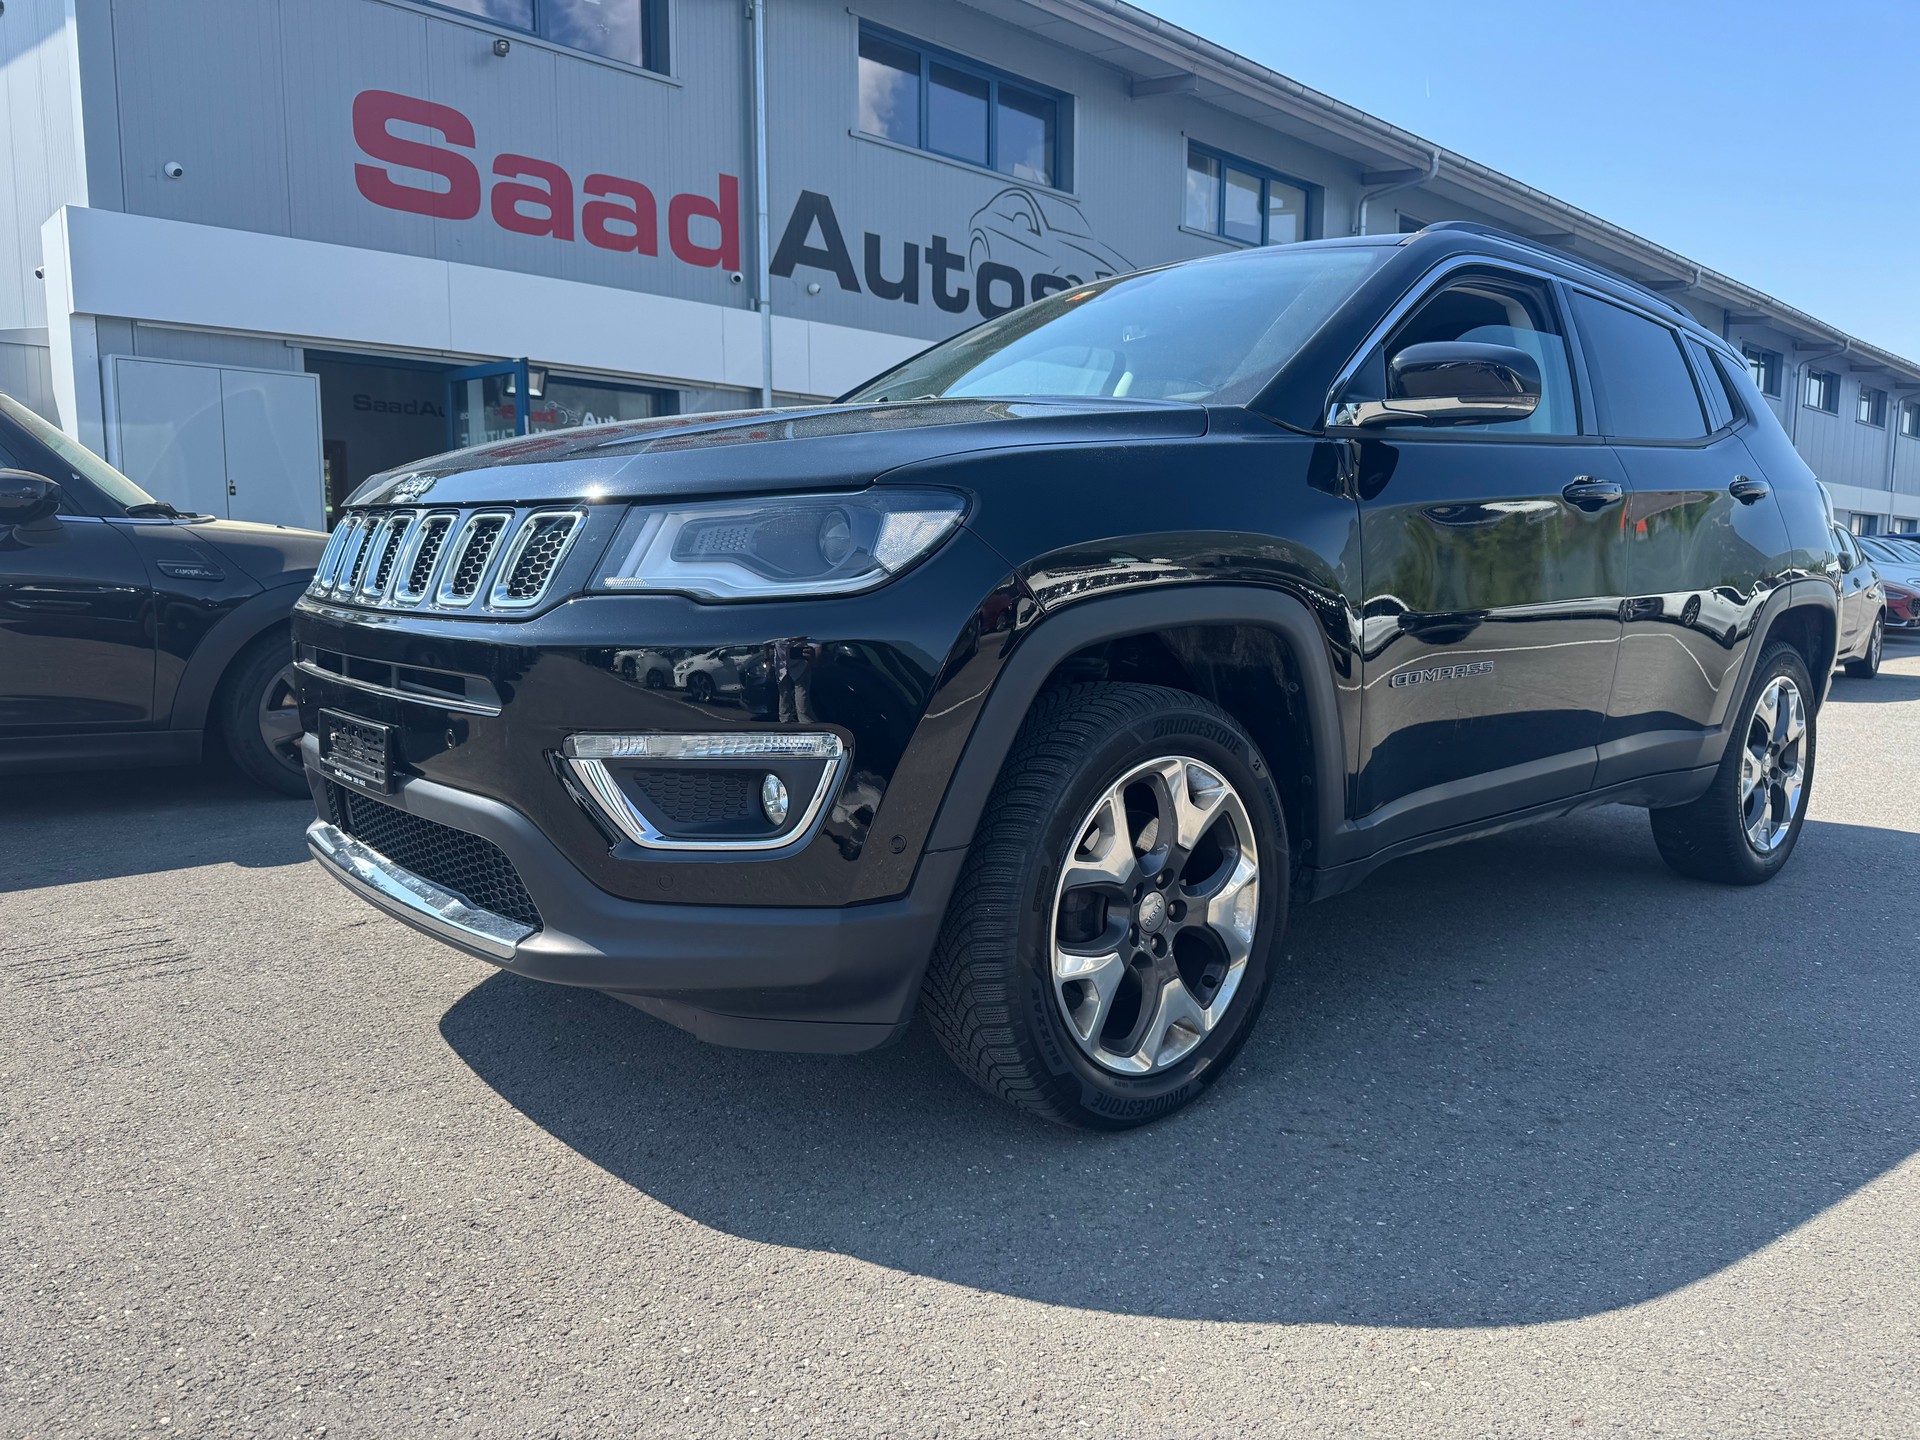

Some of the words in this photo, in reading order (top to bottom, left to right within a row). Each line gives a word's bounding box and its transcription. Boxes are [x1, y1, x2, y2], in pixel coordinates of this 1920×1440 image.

[351, 89, 741, 272] Saad
[1388, 661, 1494, 688] COMPASS
[1152, 718, 1243, 756] BRIDGESTONE
[1090, 1083, 1191, 1117] BRIDGESTONE
